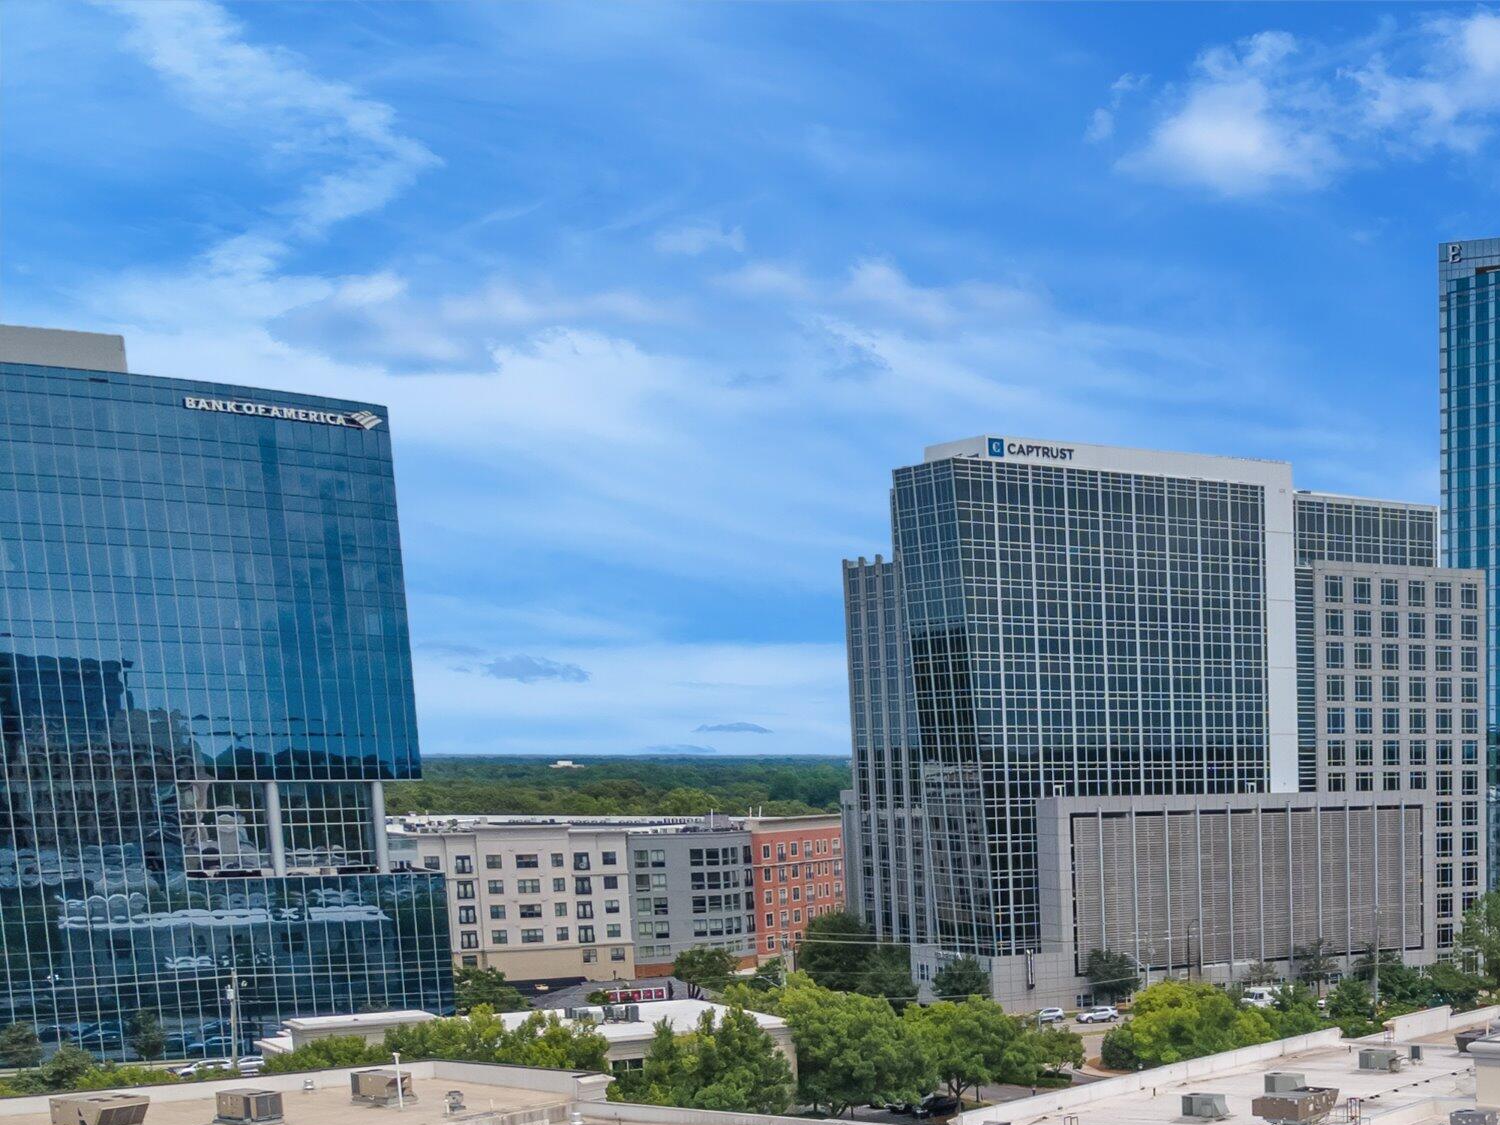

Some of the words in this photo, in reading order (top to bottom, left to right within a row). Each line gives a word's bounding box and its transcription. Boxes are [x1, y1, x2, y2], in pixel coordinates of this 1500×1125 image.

[185, 397, 237, 412] BANK
[243, 403, 270, 416] OF
[271, 407, 347, 425] AMERICA
[1007, 443, 1074, 460] CAPTRUST
